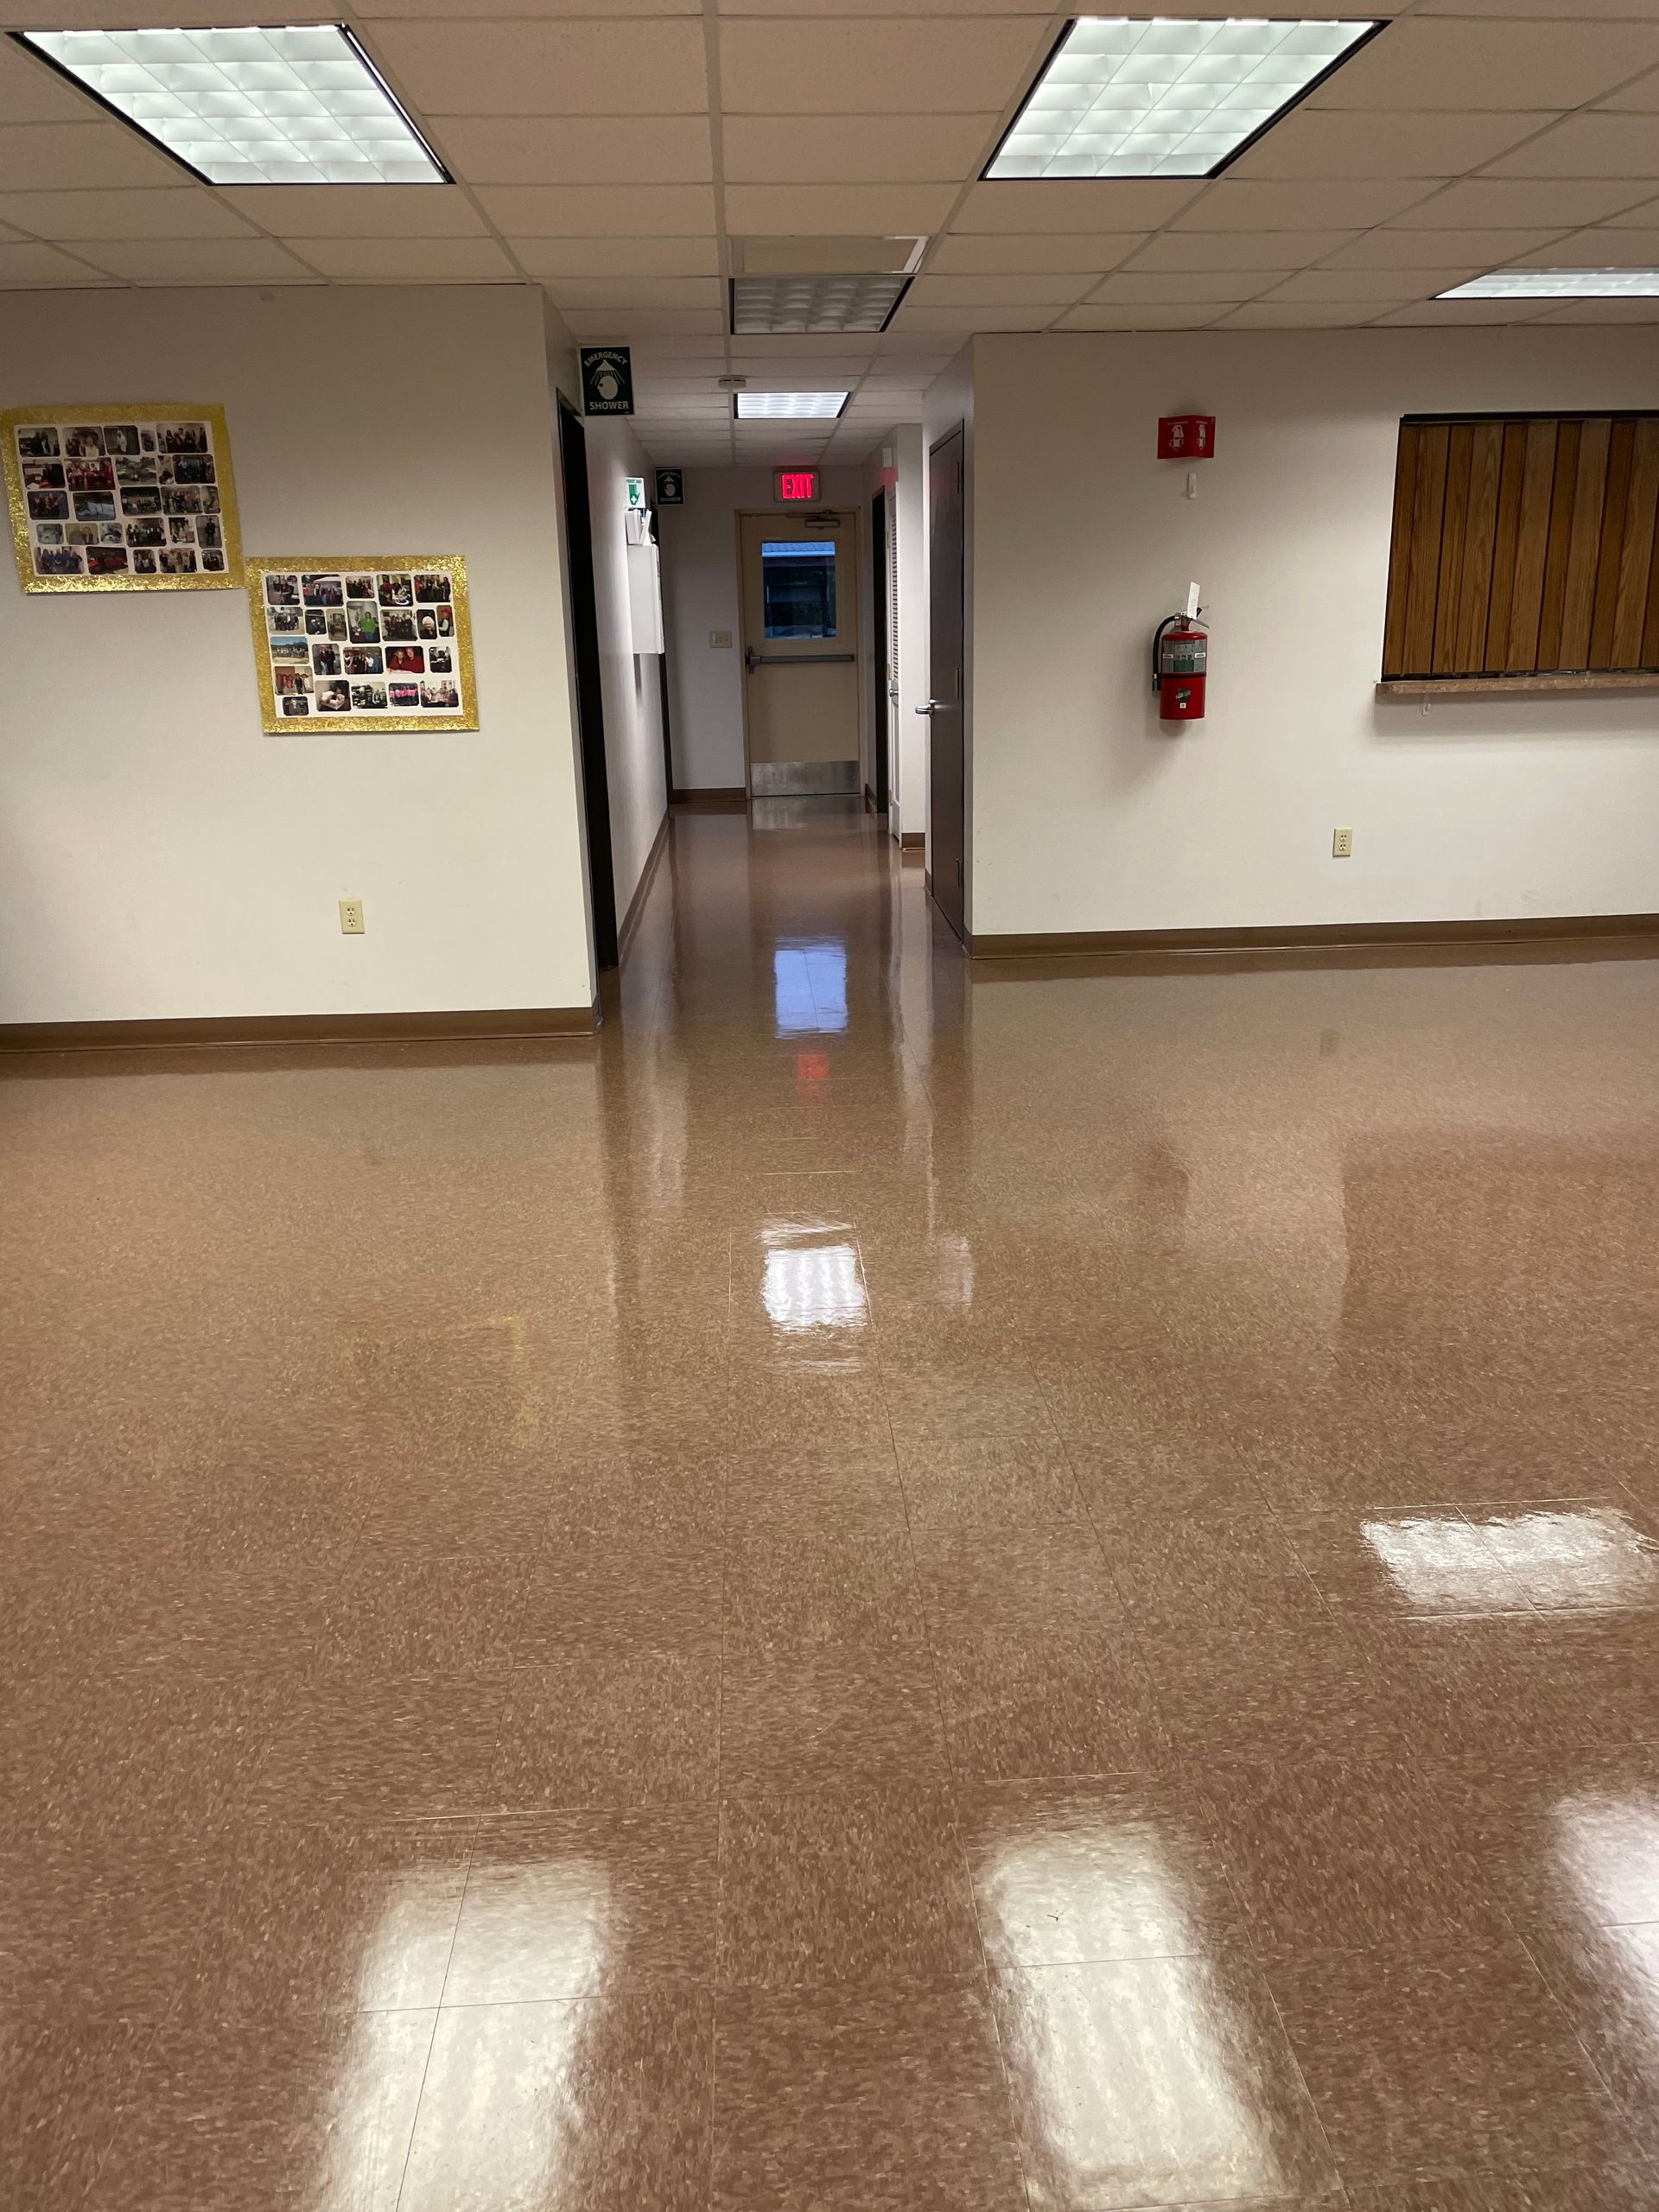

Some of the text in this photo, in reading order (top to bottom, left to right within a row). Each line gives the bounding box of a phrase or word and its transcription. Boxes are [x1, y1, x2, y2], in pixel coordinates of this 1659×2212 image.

[584, 351, 628, 367] EMERGENCY
[589, 400, 629, 410] SHOWER
[782, 474, 814, 499] EXIT
